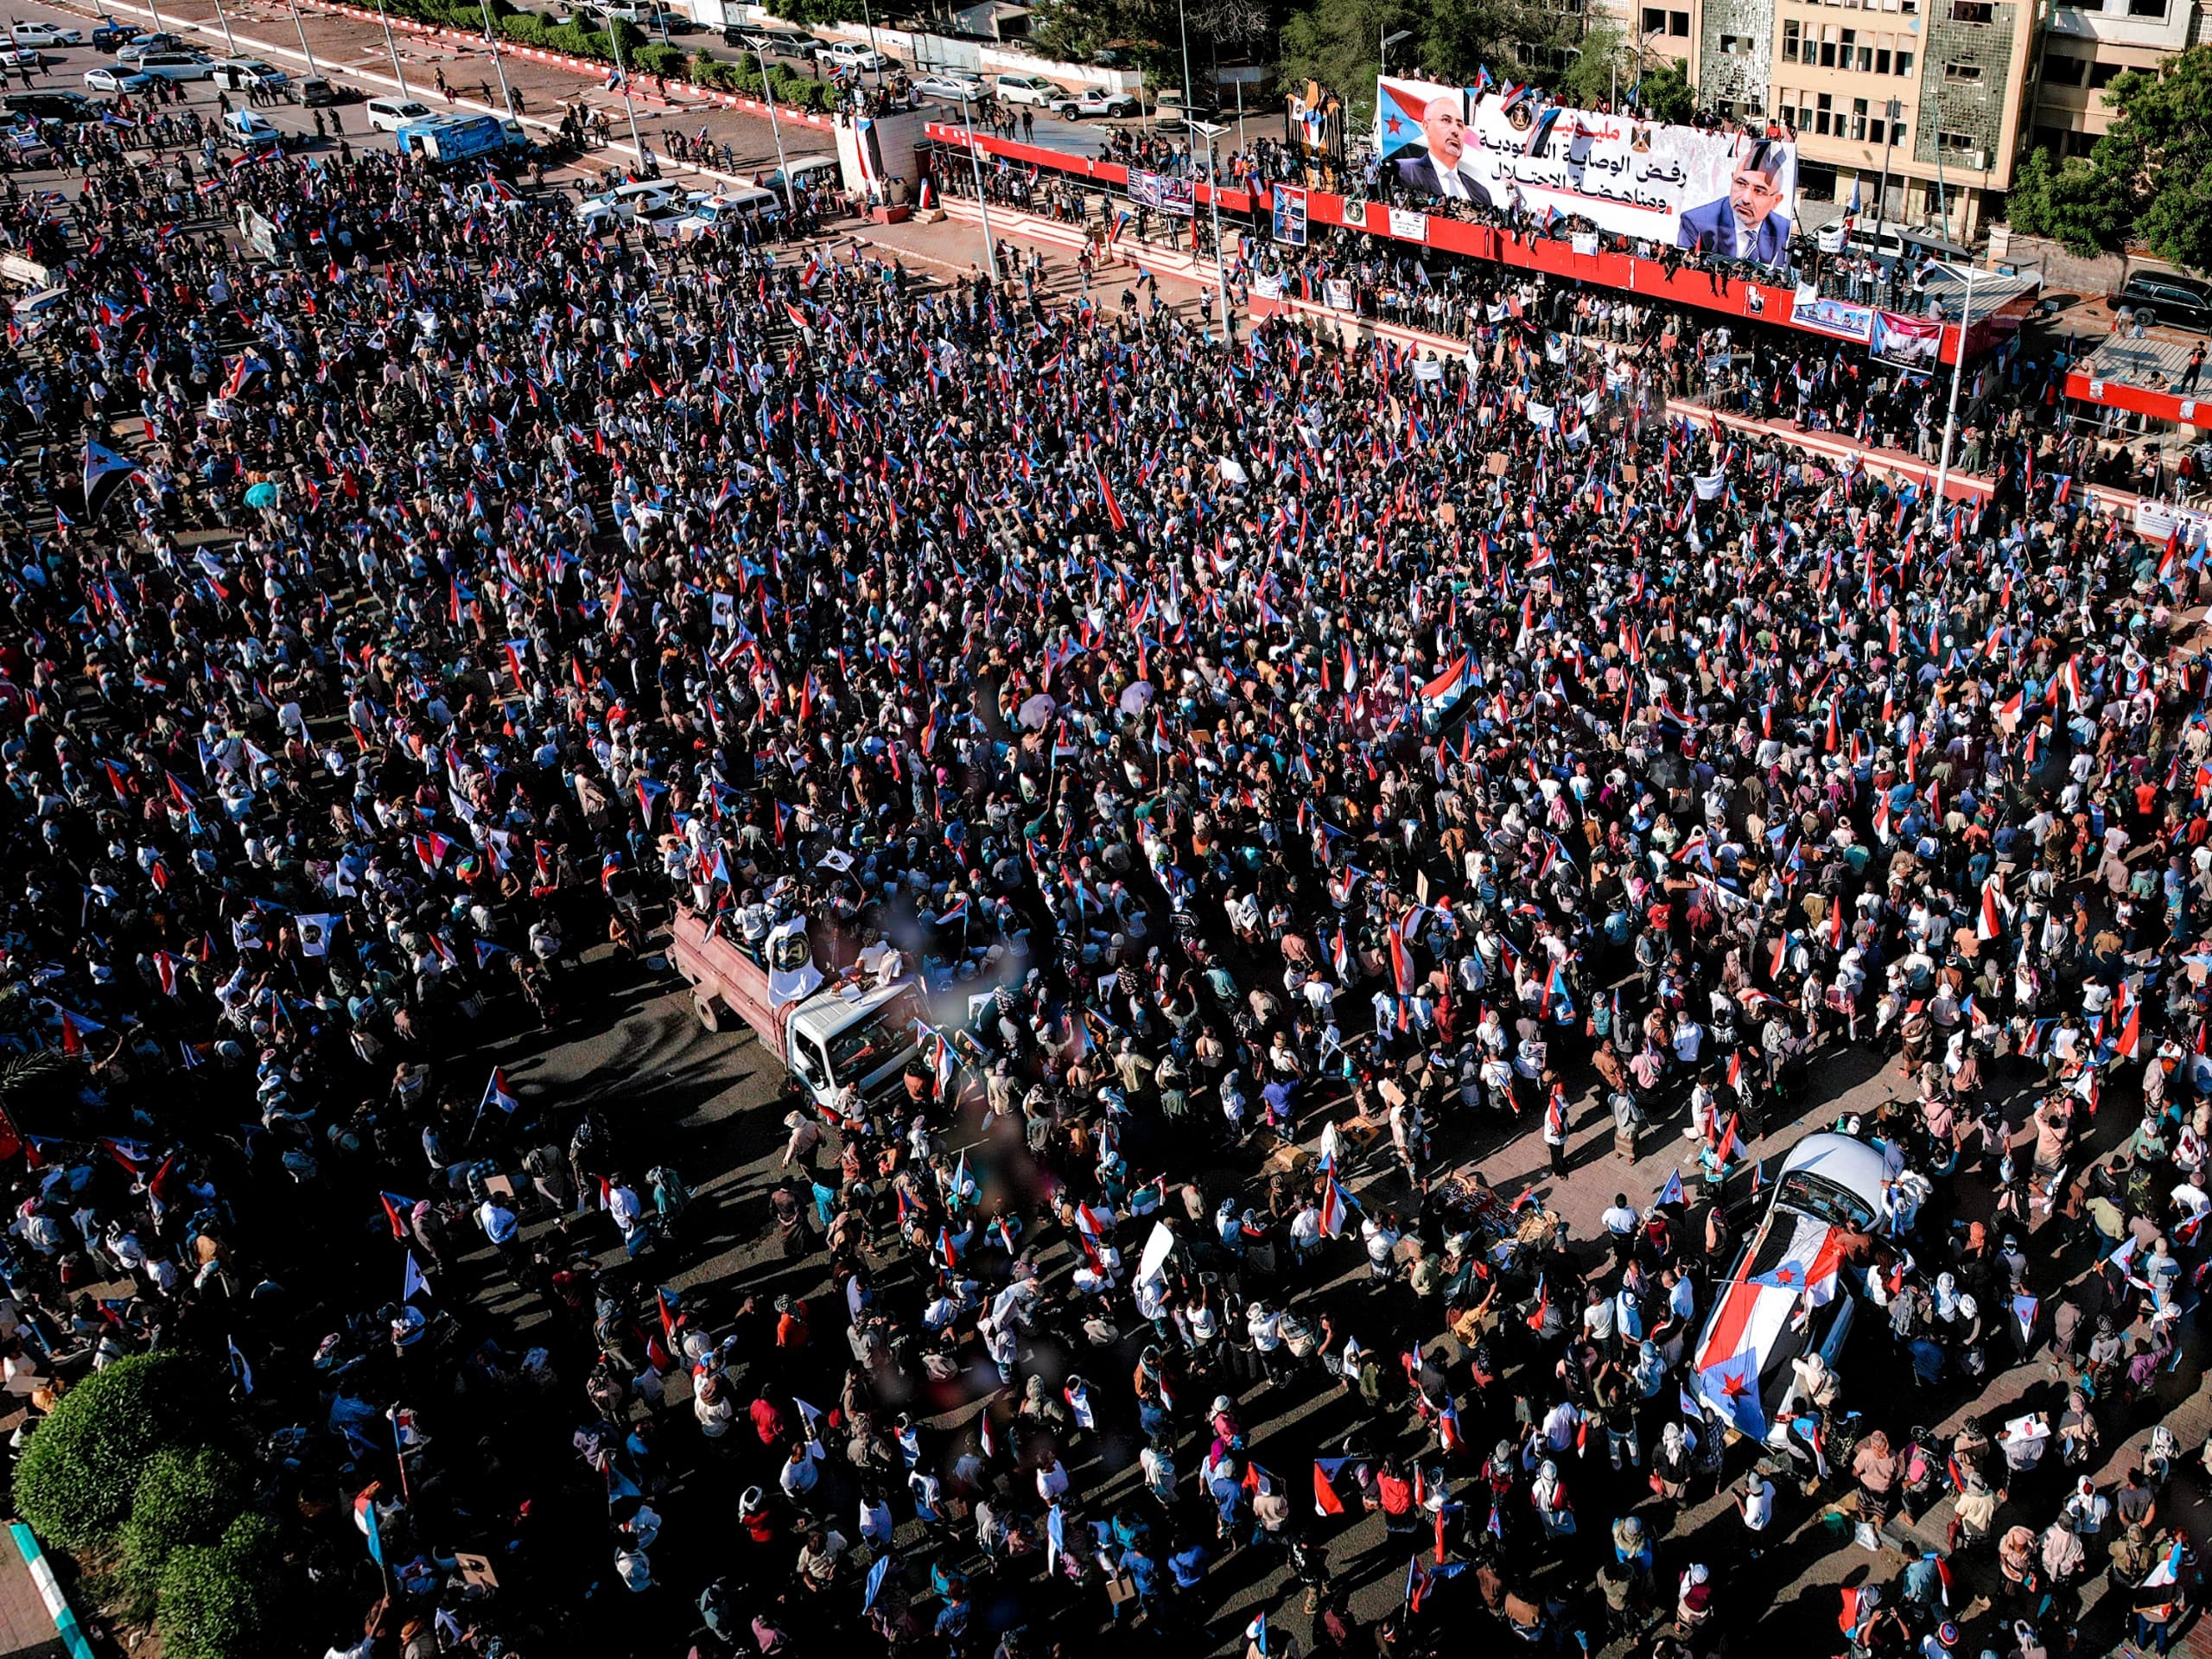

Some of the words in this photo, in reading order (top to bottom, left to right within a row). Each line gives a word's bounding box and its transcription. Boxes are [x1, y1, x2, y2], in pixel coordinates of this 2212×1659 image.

[1541, 111, 1620, 141] مليوني
[1479, 129, 1556, 161] العودية
[1562, 143, 1630, 177] الوصاية
[1491, 162, 1567, 192] الاحتلال
[1636, 160, 1688, 188] رفض
[1572, 174, 1668, 214] ومناهضة
